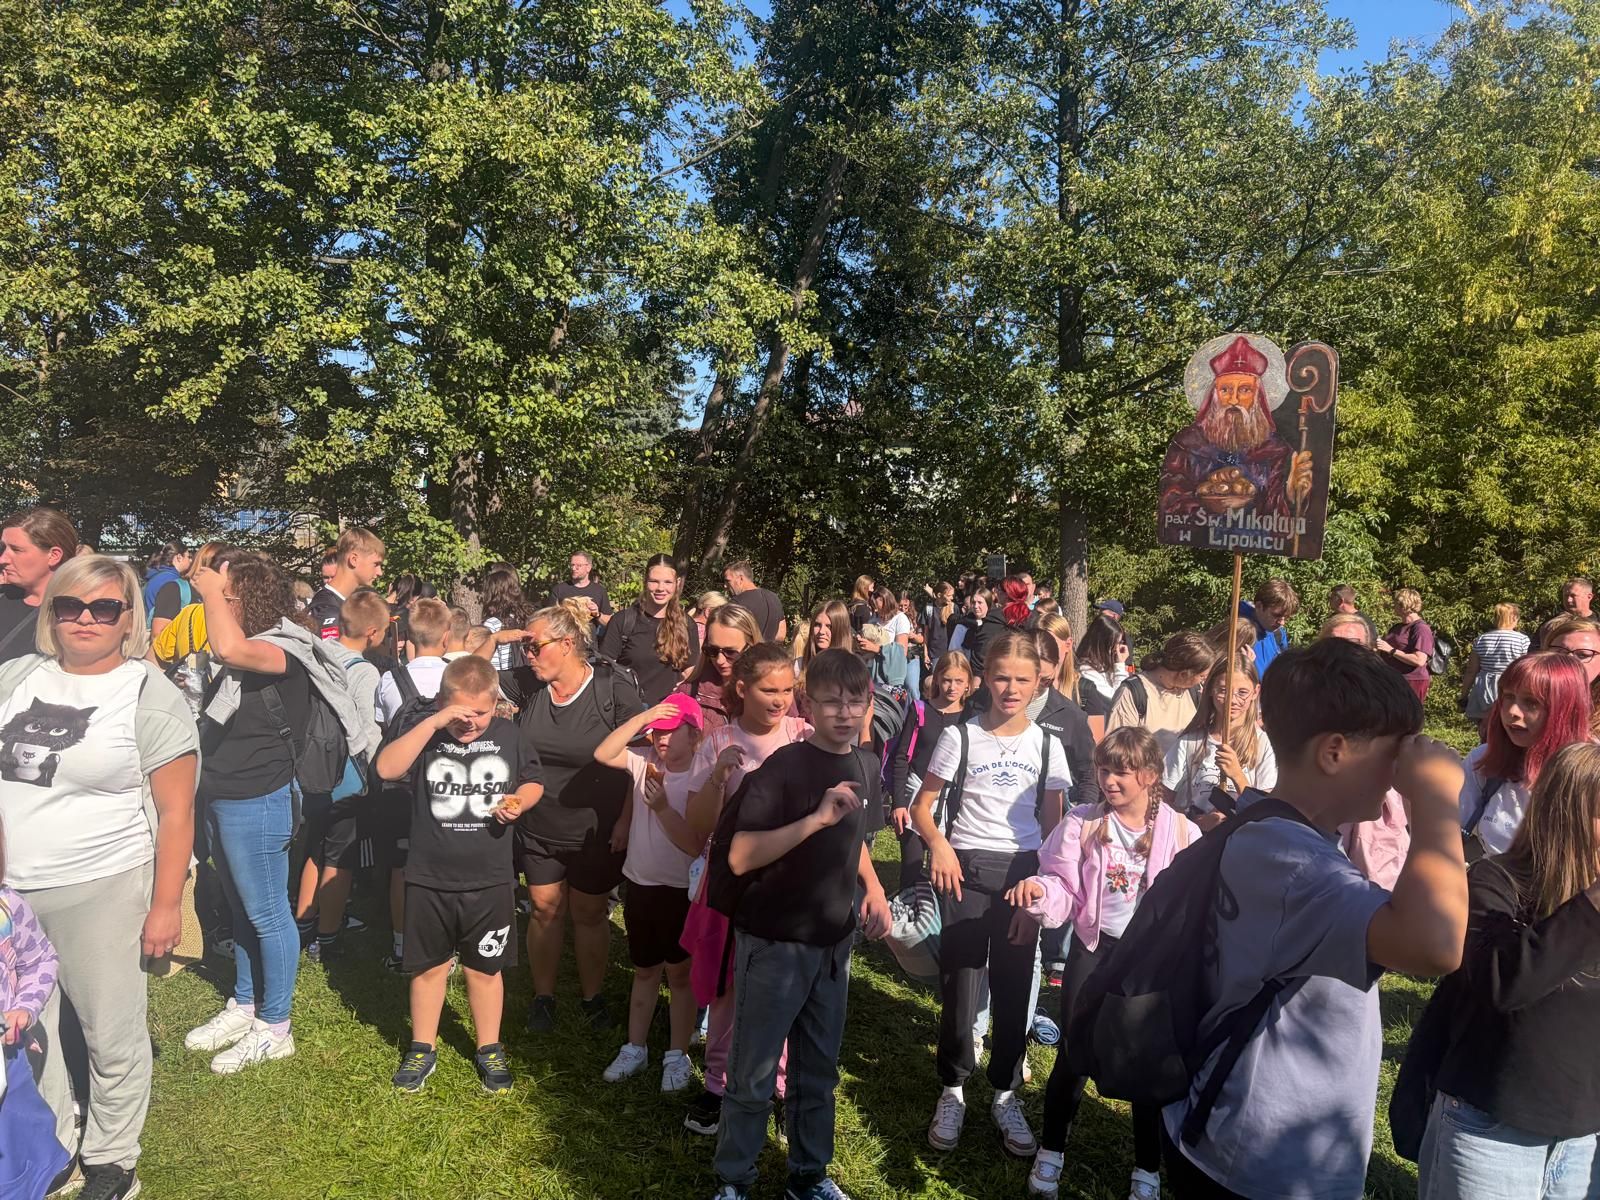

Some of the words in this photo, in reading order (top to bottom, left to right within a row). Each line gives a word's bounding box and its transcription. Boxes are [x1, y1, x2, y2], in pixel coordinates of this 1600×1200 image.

[1164, 511, 1191, 528] par.
[1226, 506, 1307, 539] Mikołaja
[1208, 527, 1284, 551] Lipowcu
[971, 764, 990, 776] SON
[450, 781, 512, 796] REASON
[478, 924, 511, 958] 67
